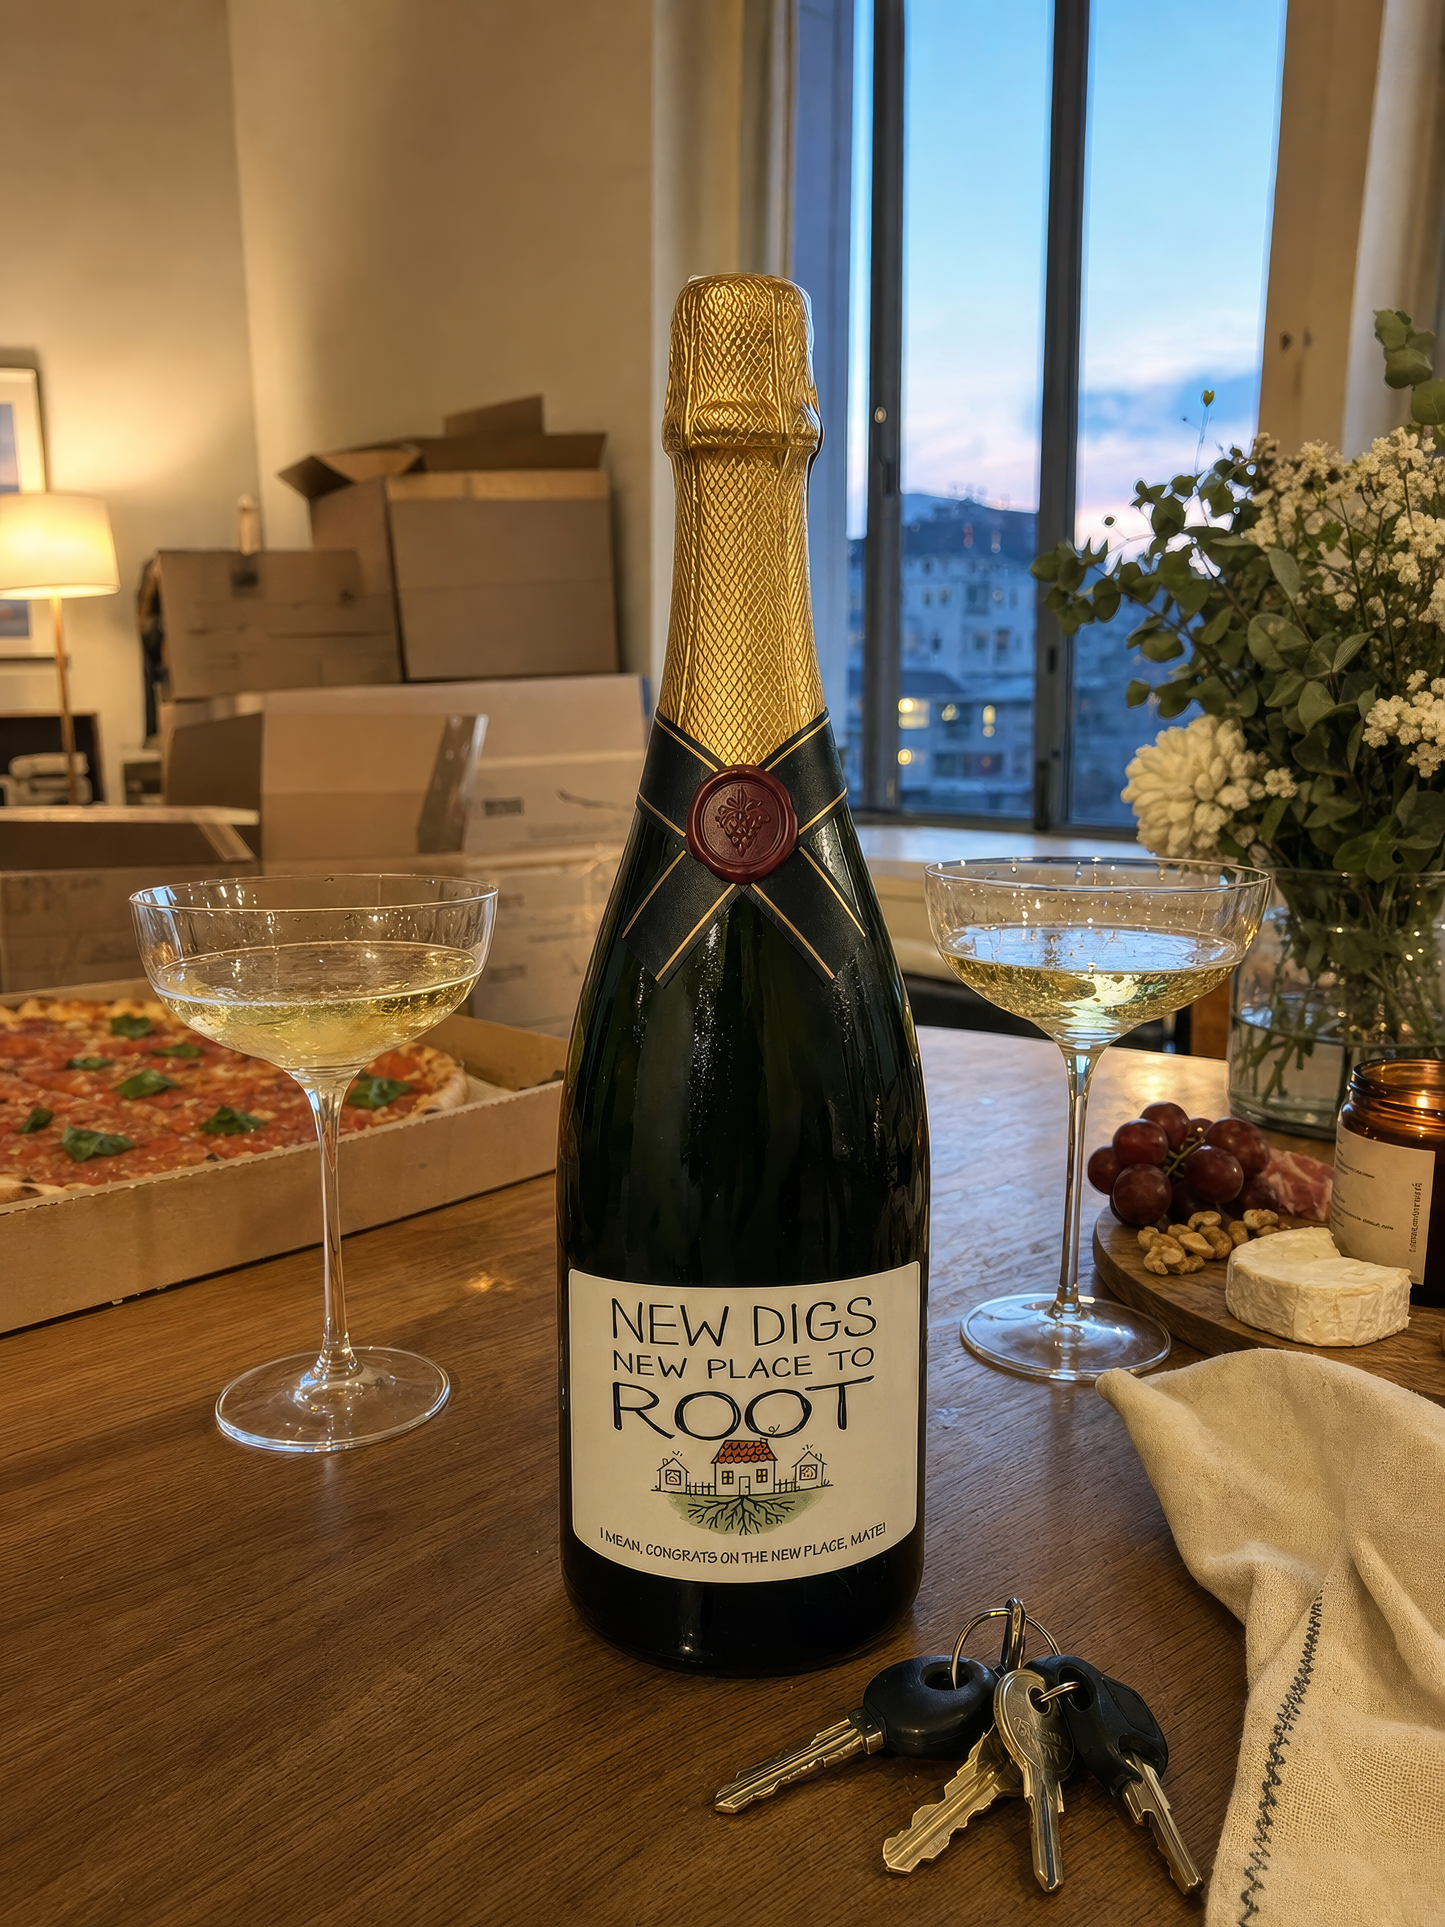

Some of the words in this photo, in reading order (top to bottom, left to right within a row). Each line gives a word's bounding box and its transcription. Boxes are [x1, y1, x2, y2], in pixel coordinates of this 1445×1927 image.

[611, 1297, 729, 1347] NEW
[753, 1296, 877, 1346] DIGS
[613, 1349, 687, 1379] NEW
[707, 1355, 813, 1379] PLACE
[827, 1347, 875, 1371] TO
[612, 1375, 875, 1441] ROOT
[605, 1530, 643, 1554] MEAN,
[645, 1544, 717, 1563] CONGRATS
[720, 1552, 739, 1564] ON
[741, 1551, 768, 1563] THE
[771, 1547, 802, 1561] NEW
[804, 1537, 848, 1557] PLACE,
